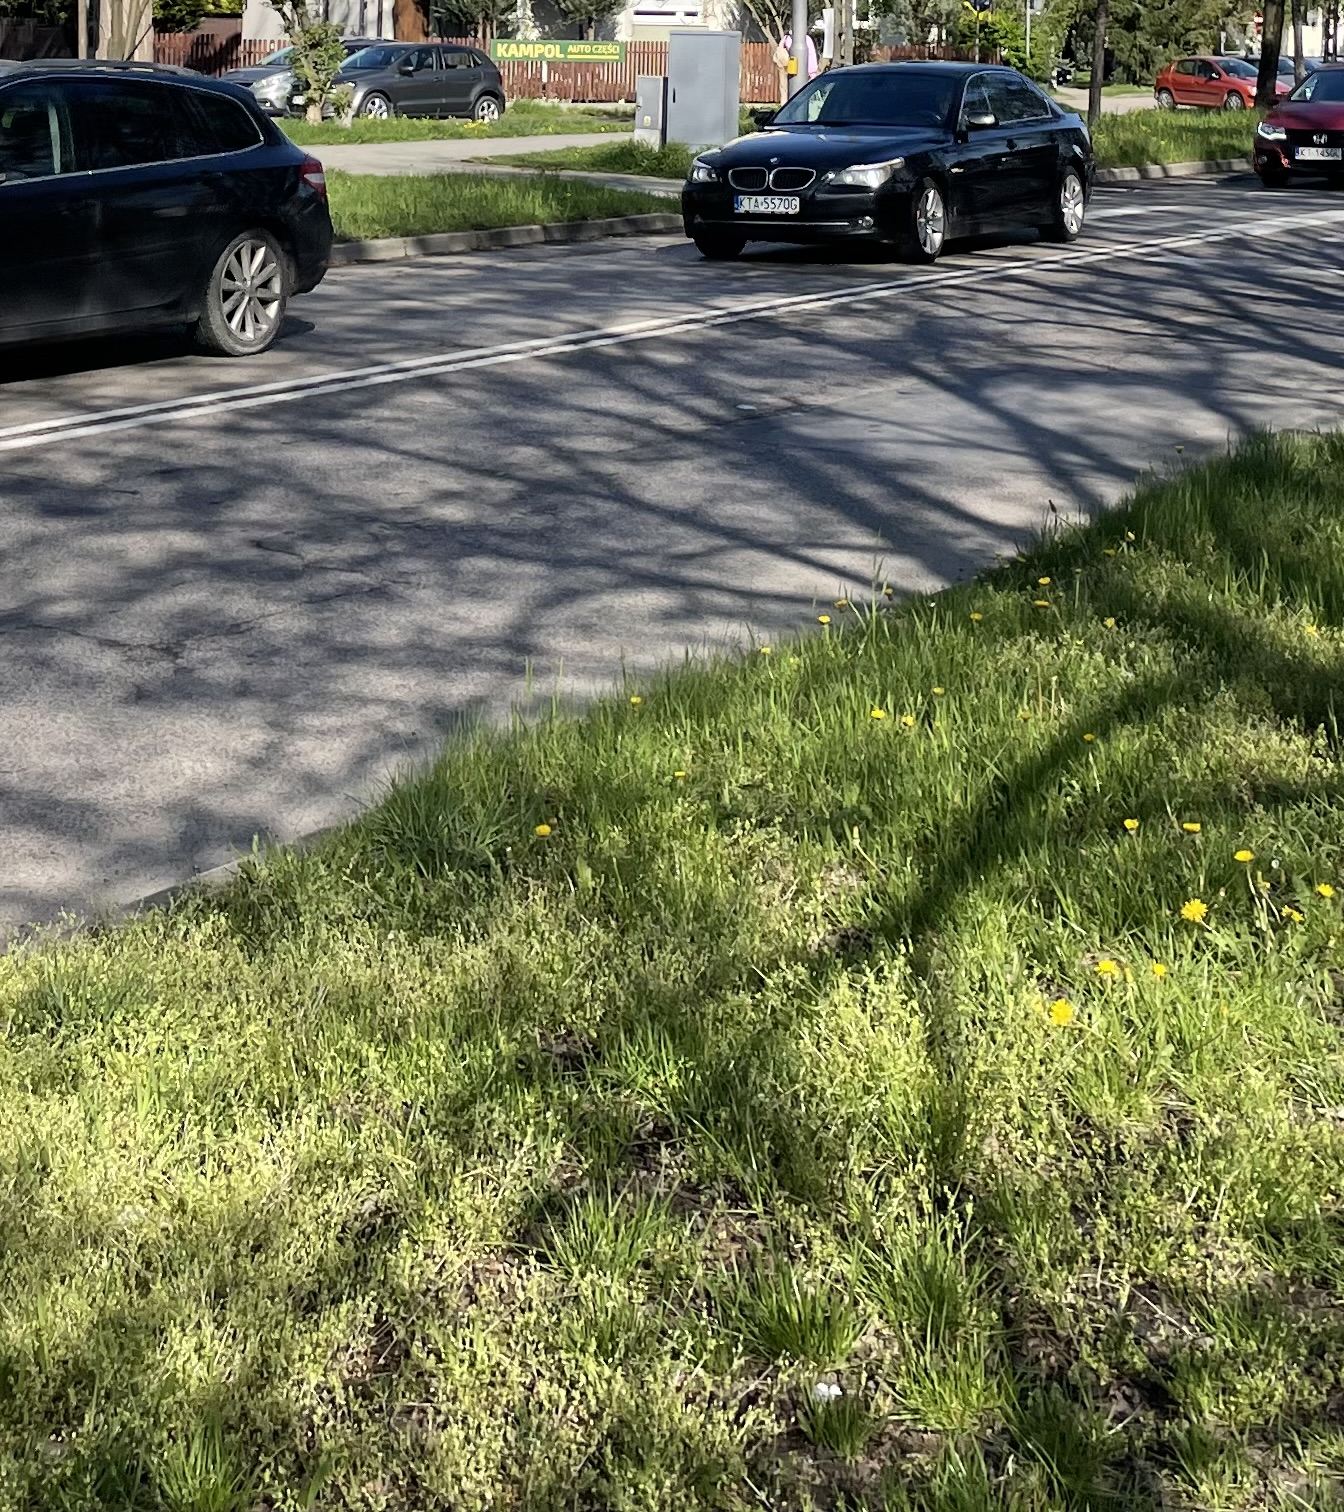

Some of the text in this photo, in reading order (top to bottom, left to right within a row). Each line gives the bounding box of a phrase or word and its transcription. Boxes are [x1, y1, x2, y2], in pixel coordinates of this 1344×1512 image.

[497, 42, 620, 58] KAMPOL AUTO CZĘŚCI
[739, 196, 798, 210] KTA 5570G
